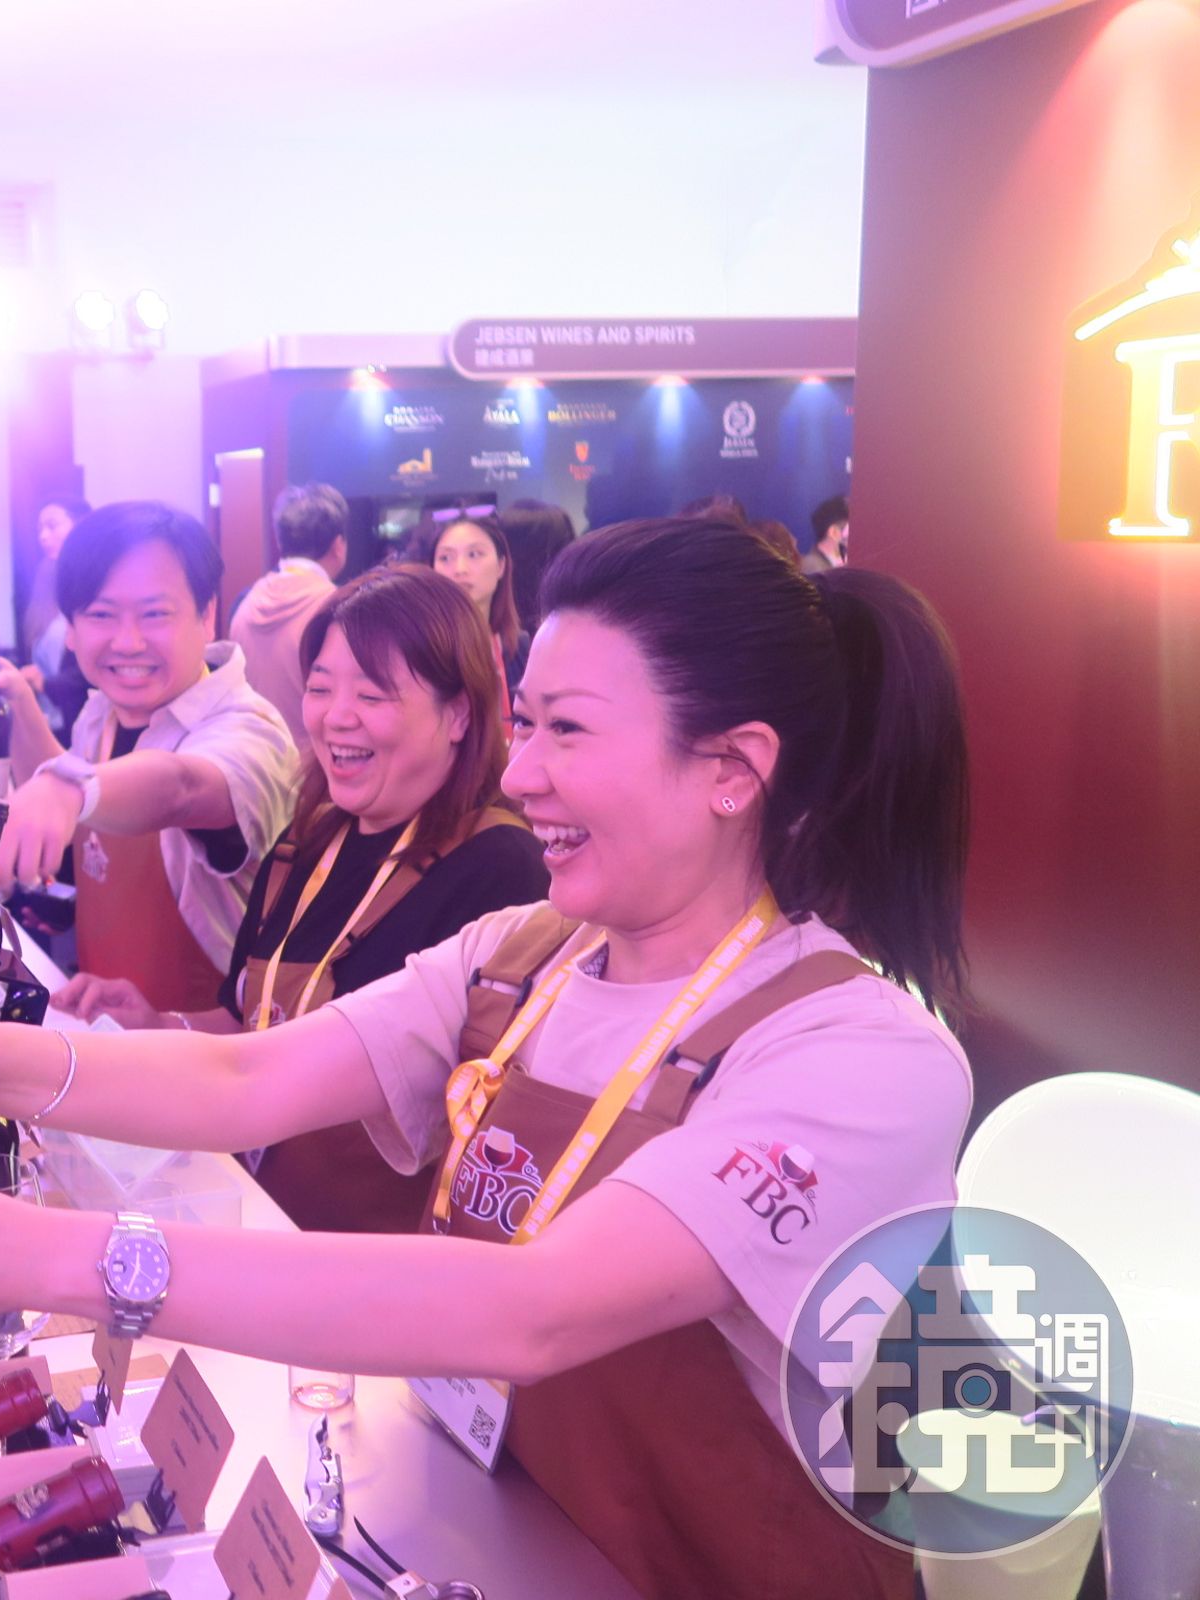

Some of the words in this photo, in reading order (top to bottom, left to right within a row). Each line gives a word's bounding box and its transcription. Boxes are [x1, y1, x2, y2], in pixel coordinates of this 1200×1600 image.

[475, 326, 537, 344] JEBSEN
[541, 326, 594, 344] WINES
[597, 326, 631, 344] AND
[634, 326, 695, 344] SPIRITS
[451, 1160, 540, 1236] FBC
[711, 1146, 812, 1245] FBC
